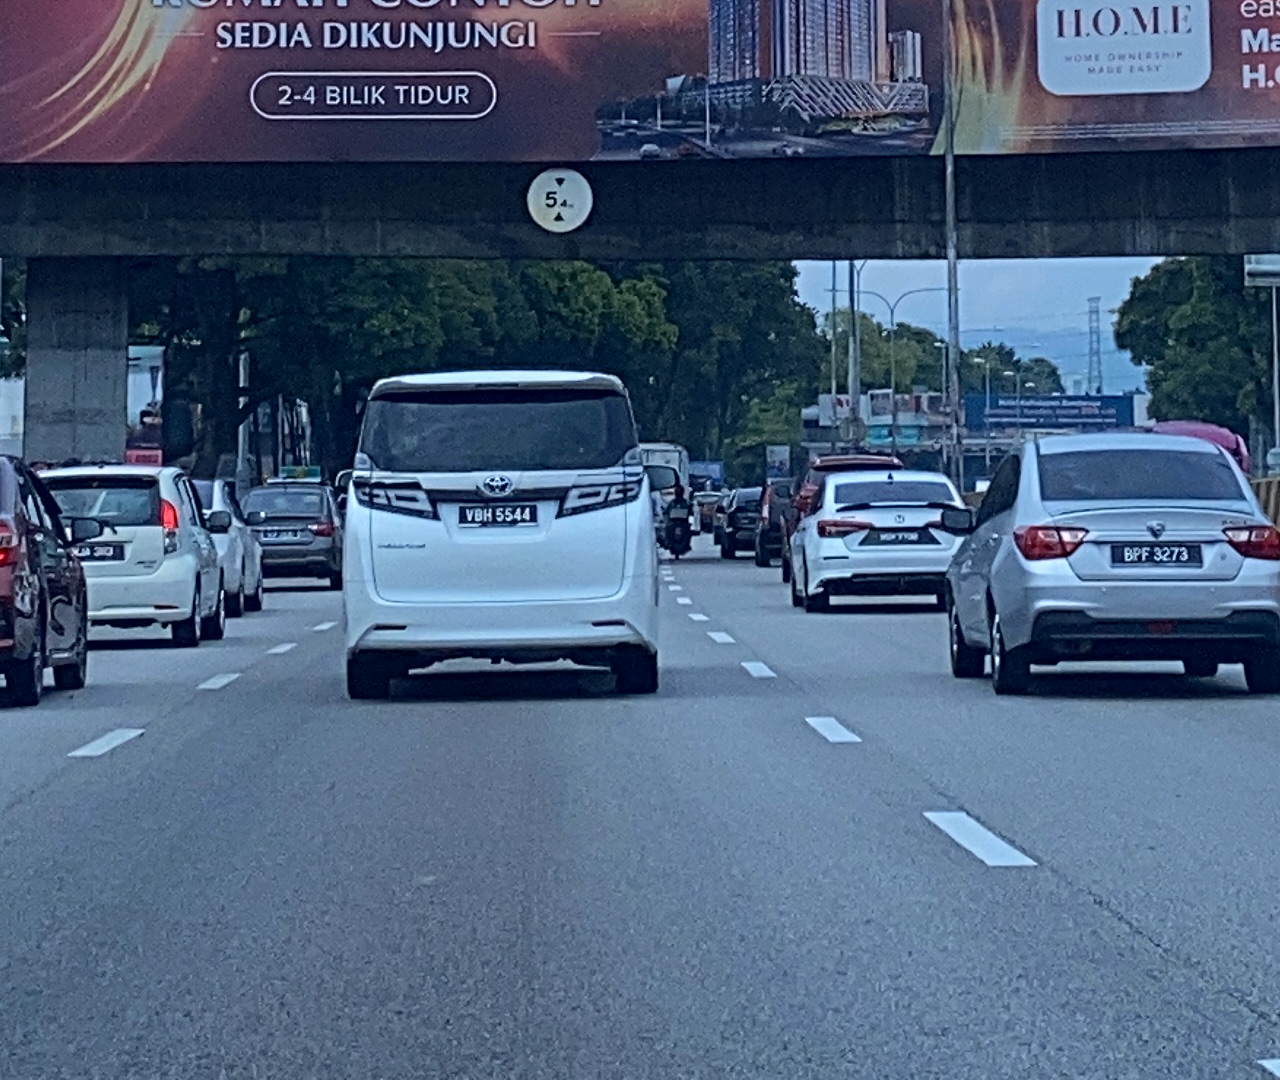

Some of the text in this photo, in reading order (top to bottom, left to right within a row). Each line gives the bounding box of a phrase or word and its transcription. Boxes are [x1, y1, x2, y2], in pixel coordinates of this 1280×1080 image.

[1056, 5, 1193, 38] H.O.M.E
[216, 22, 536, 53] SEDIA DIKUNJUNGI
[1064, 51, 1183, 63] HOME OWNERSHIP
[1087, 64, 1161, 75] MADE EASY
[277, 85, 470, 105] 2-4 BILIK TIDUR
[495, 507, 531, 522] 5544
[1123, 546, 1189, 562] BPF 3273
